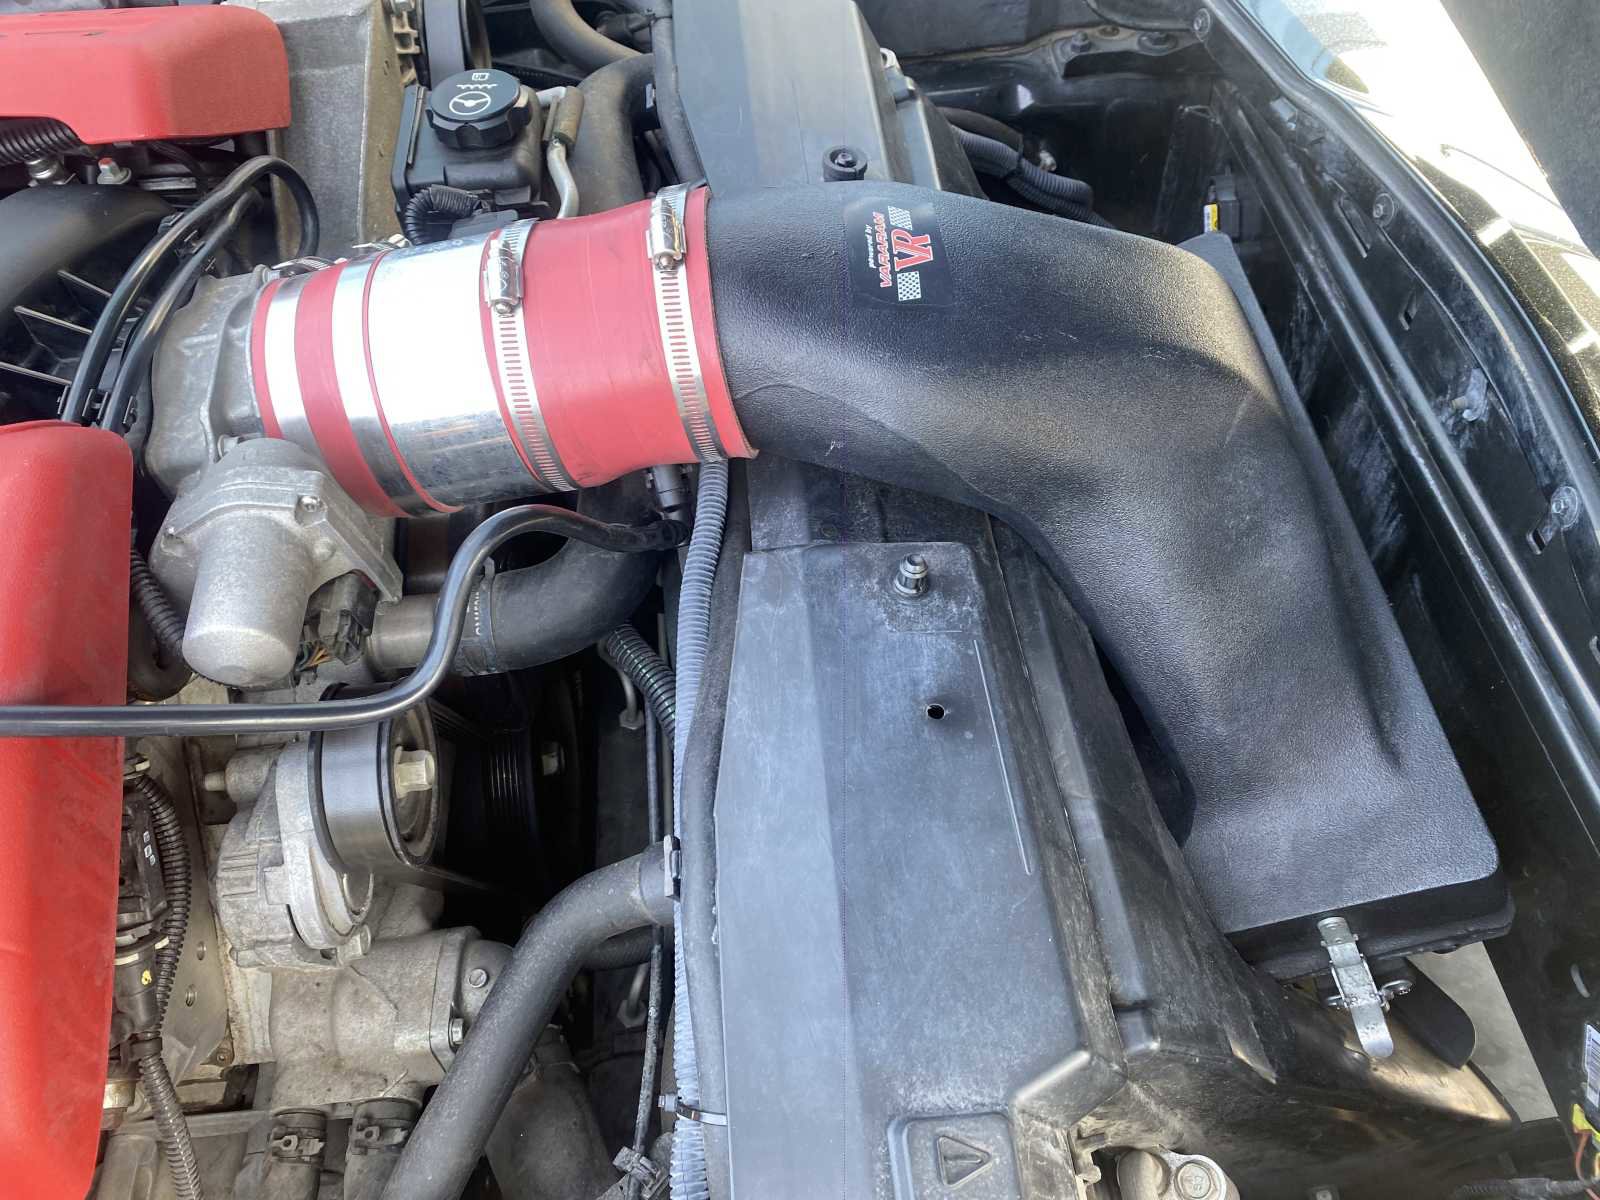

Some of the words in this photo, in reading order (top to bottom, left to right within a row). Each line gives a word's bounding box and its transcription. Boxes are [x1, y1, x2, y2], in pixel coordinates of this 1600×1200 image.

[865, 224, 873, 234] by
[865, 234, 877, 268] powered
[891, 228, 934, 272] VR
